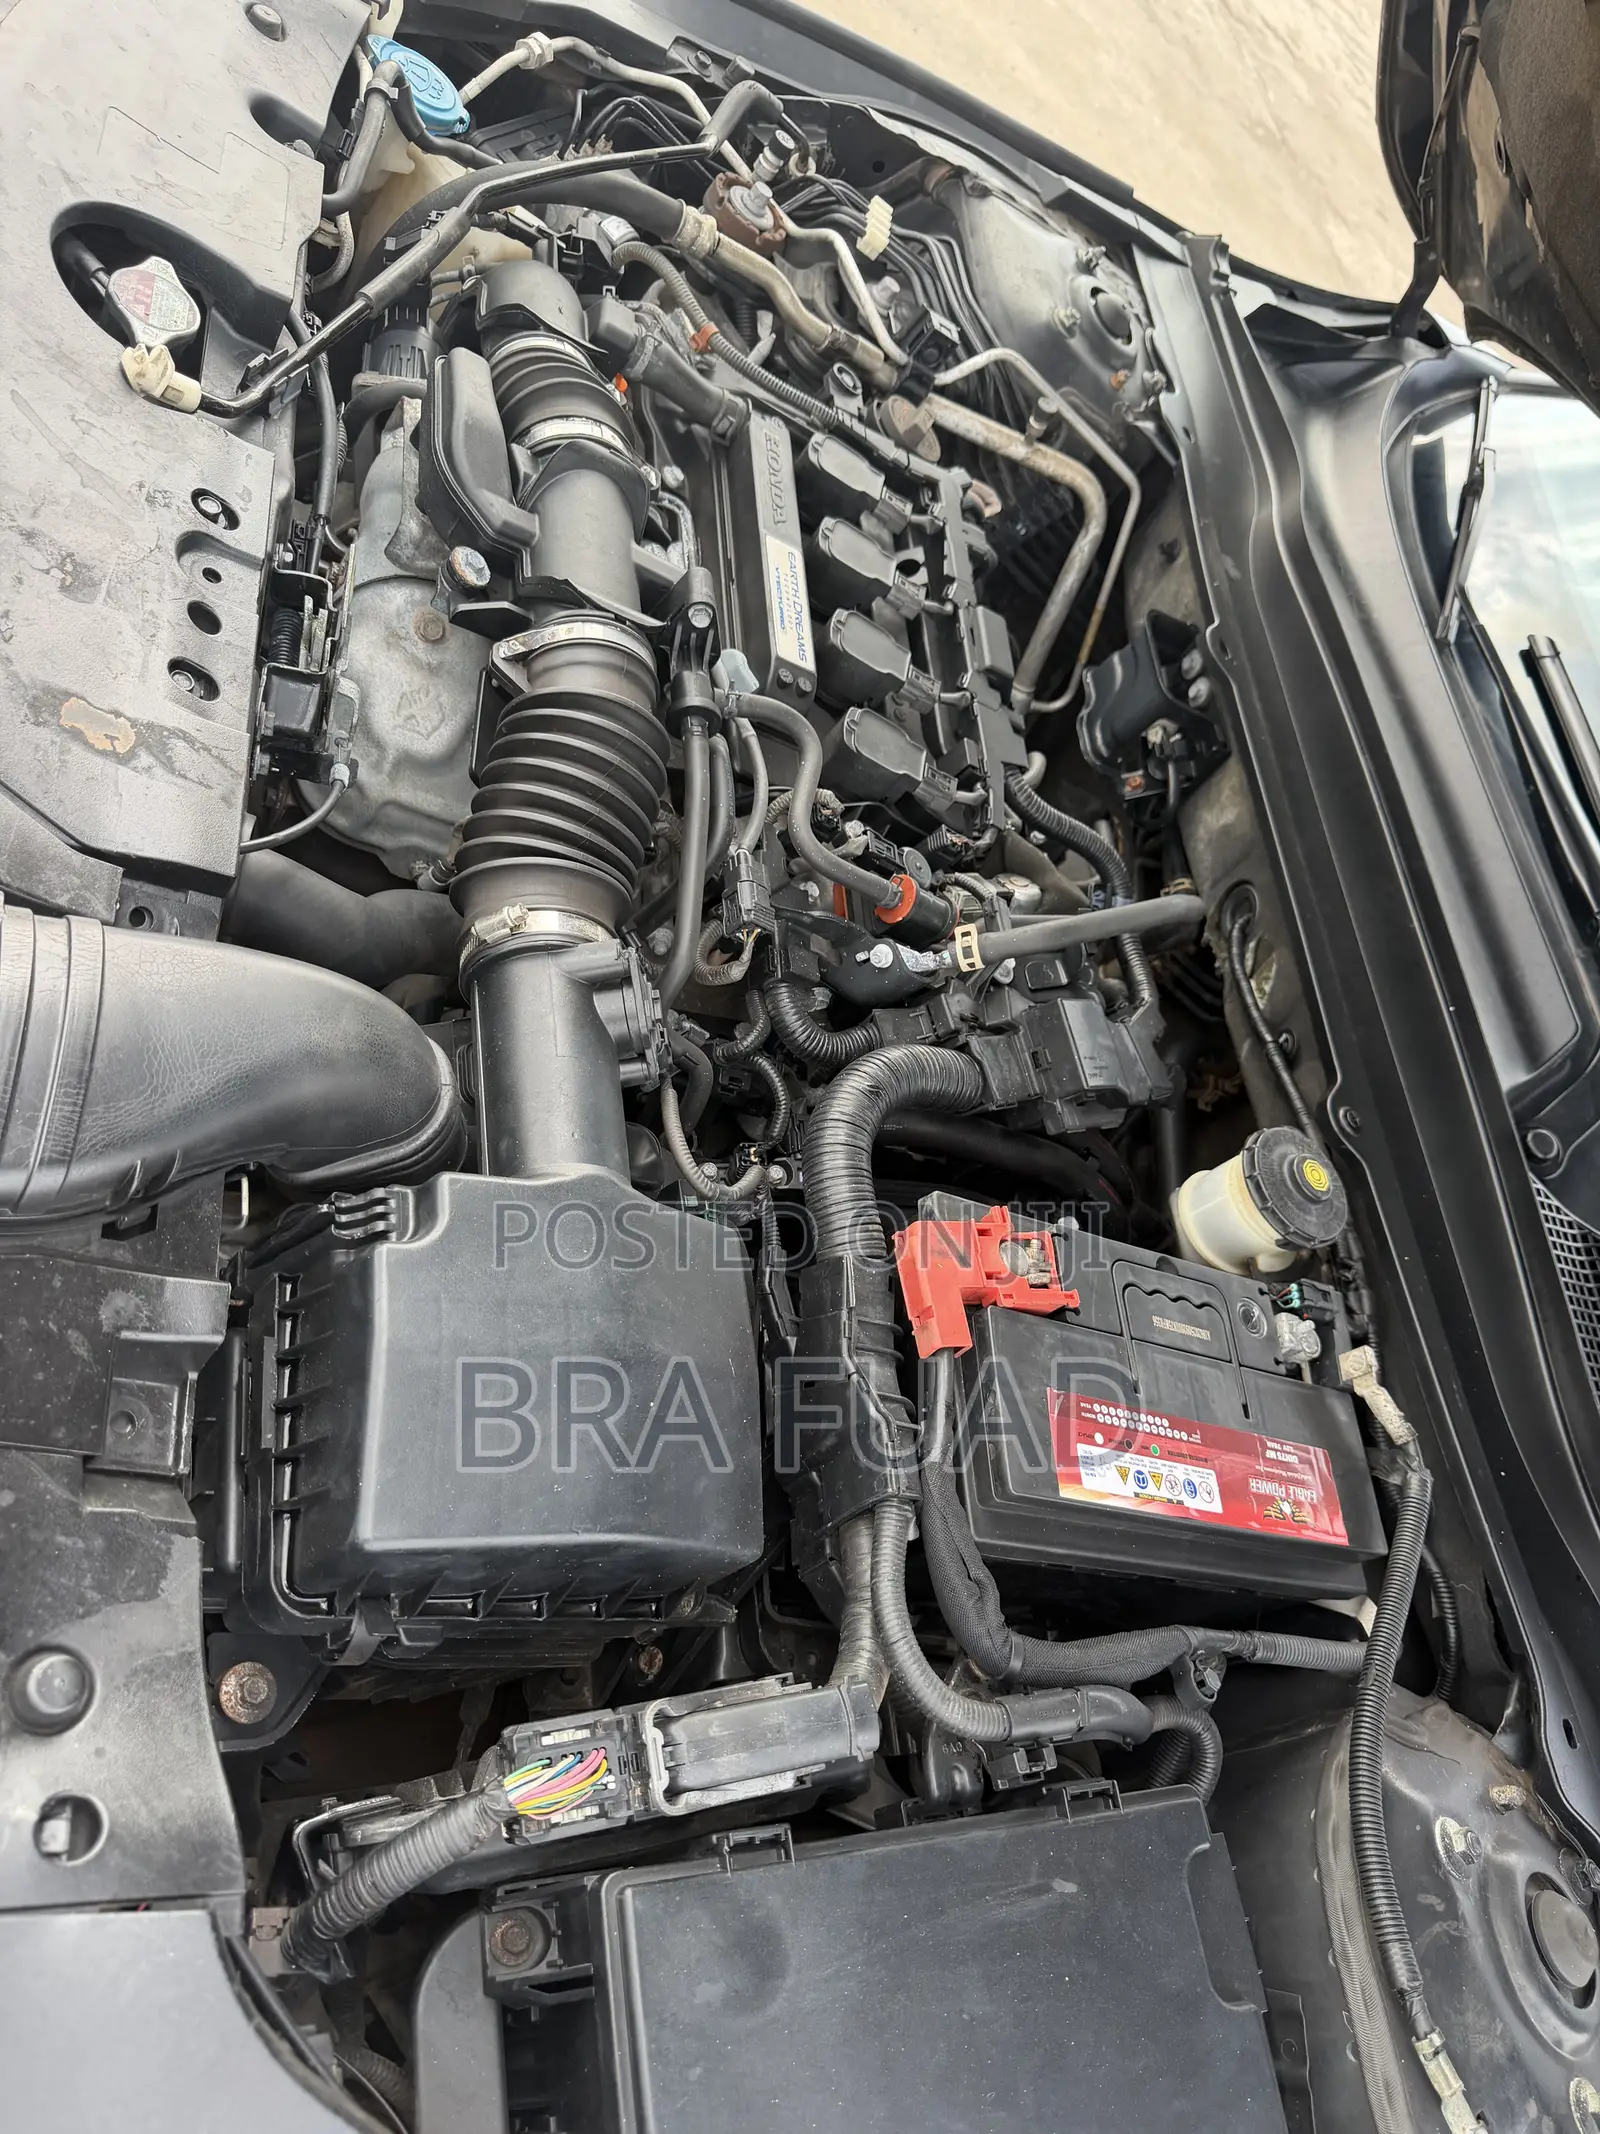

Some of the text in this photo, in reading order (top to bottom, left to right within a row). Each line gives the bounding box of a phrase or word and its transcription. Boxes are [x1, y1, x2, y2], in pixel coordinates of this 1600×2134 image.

[765, 431, 787, 526] HONDA
[788, 552, 808, 662] EARTH DREAMS
[1248, 1477, 1317, 1503] EAGLE POWER
